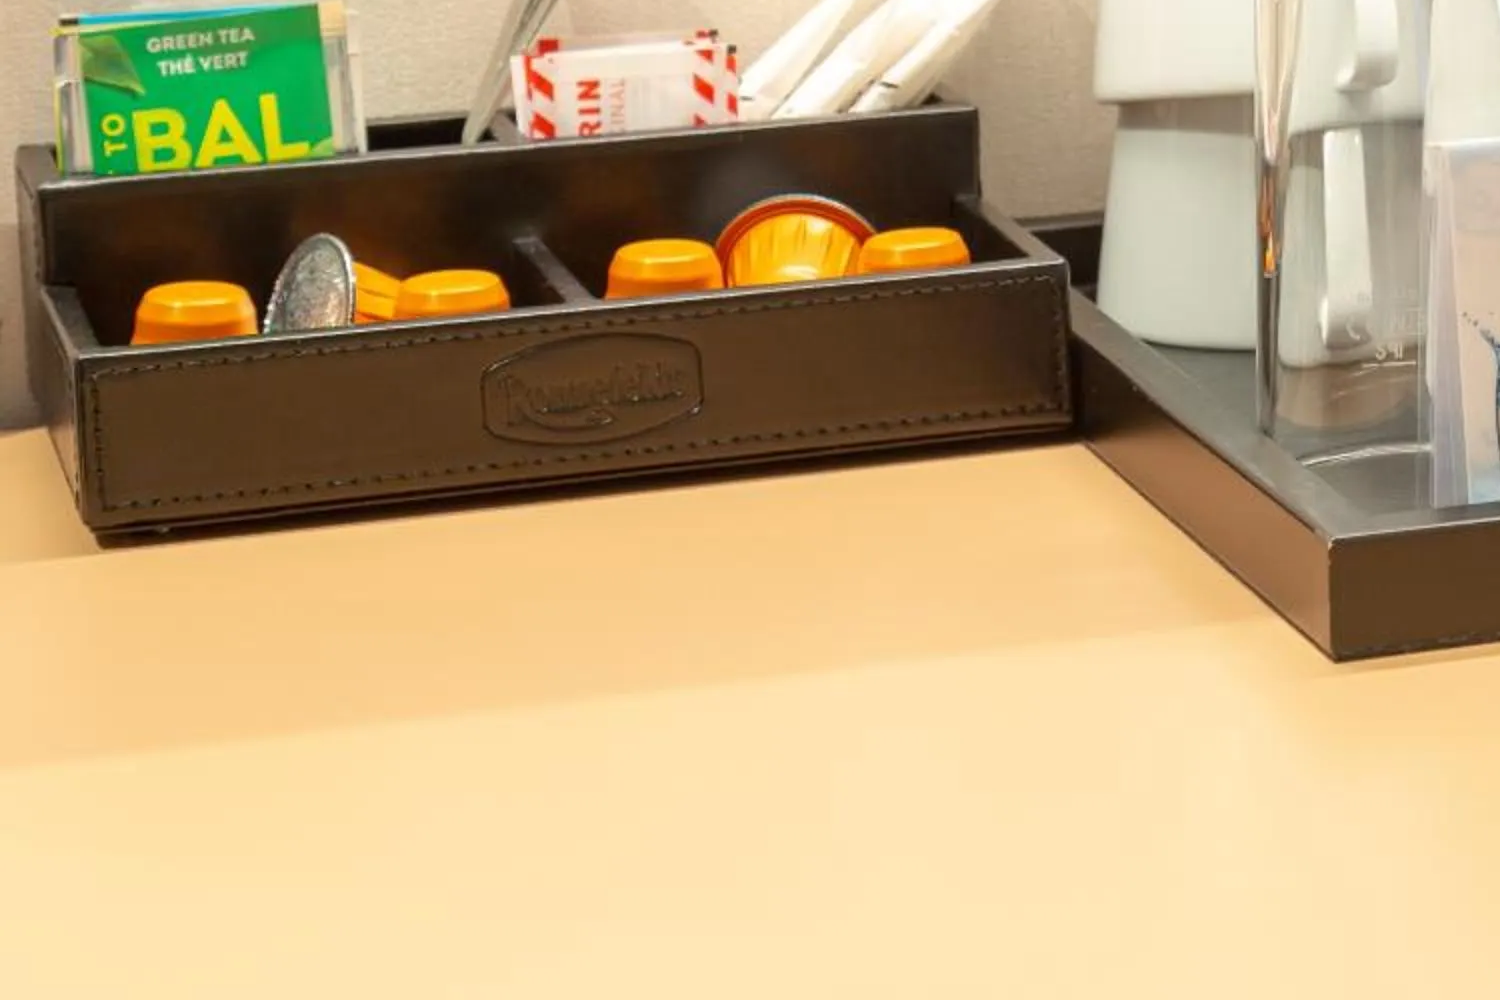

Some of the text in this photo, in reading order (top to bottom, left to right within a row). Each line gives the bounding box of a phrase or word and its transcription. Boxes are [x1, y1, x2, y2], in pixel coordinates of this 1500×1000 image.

[146, 27, 256, 53] GREEN TEA
[157, 51, 249, 77] THÉ VERT
[132, 92, 310, 173] BAL
